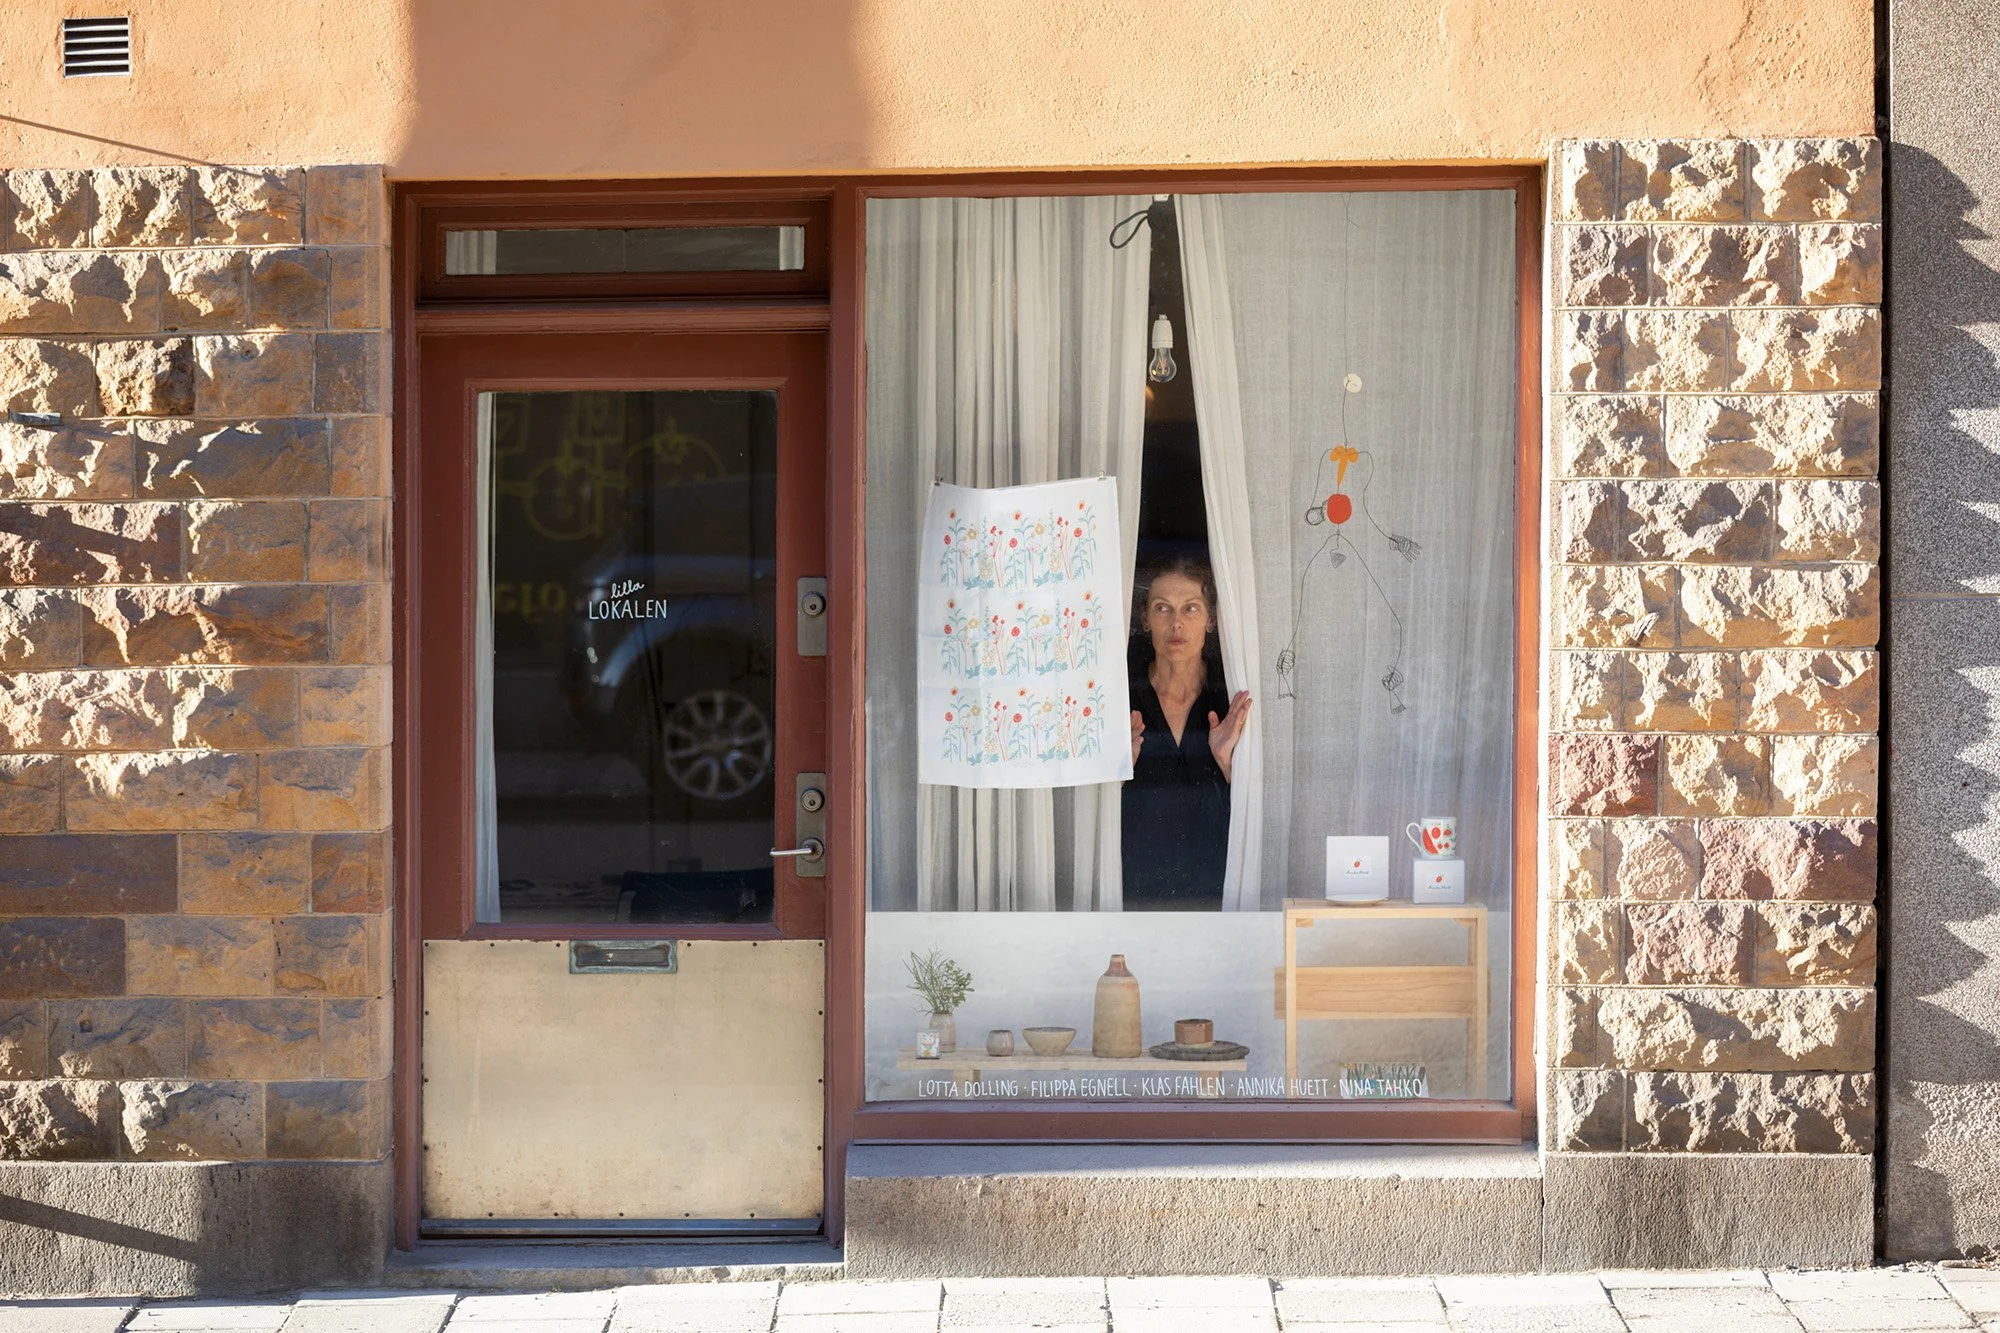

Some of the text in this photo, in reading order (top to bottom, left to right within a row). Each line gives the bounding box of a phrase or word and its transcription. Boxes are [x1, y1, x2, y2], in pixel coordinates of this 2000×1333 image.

[611, 579, 645, 599] lilla
[589, 599, 667, 620] LOKALEN
[918, 1079, 959, 1098] LOTTA
[1031, 1078, 1077, 1098] FILIPPA
[1081, 1077, 1132, 1097] EGNELL
[1141, 1077, 1172, 1096] KLAS
[1236, 1076, 1286, 1096] ANNIKA
[1290, 1077, 1329, 1097] HUETT
[1339, 1078, 1373, 1097] NINA
[1376, 1078, 1422, 1098] TAHKO
